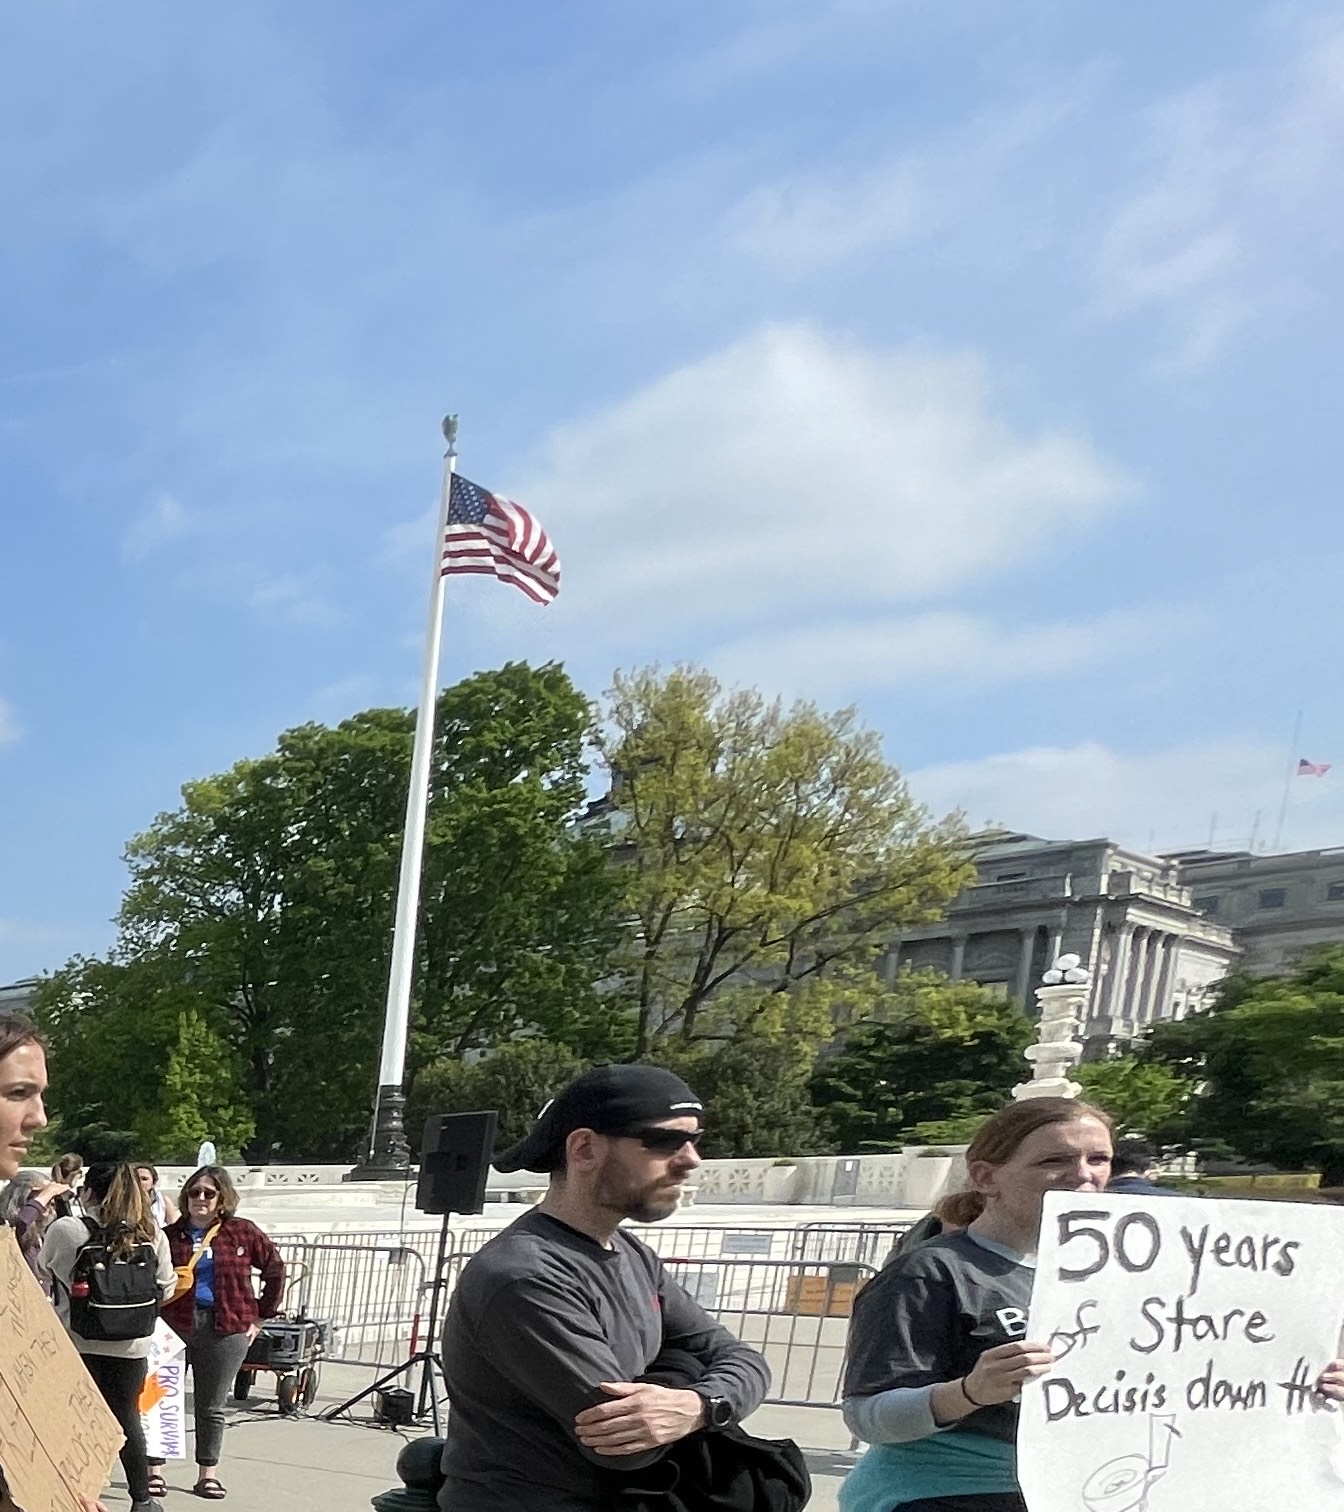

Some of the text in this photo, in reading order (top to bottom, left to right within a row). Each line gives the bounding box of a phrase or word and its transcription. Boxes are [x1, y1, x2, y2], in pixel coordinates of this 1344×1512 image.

[1056, 1210, 1302, 1297] 50 years
[1048, 1299, 1101, 1362] of
[1129, 1295, 1275, 1354] Stare
[158, 1365, 180, 1398] PRO
[1041, 1369, 1166, 1424] Decisis
[1186, 1358, 1266, 1411] down
